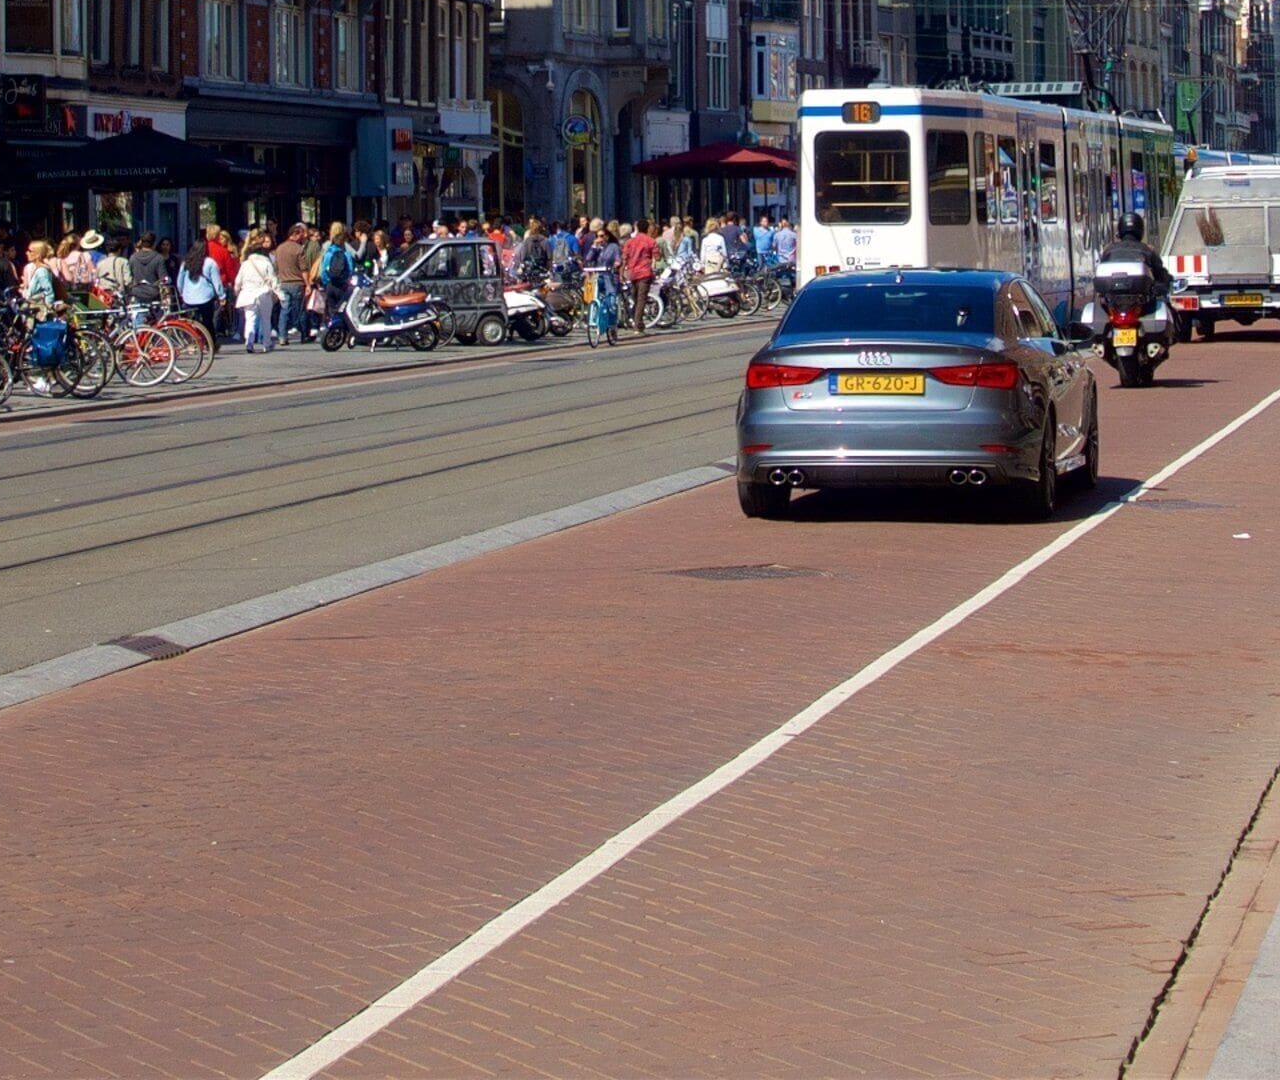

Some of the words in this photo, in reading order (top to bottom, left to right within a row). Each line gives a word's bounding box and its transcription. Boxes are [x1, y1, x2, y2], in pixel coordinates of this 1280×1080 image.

[853, 103, 871, 122] 16
[853, 235, 872, 246] 817
[844, 377, 918, 391] GR-620-J
